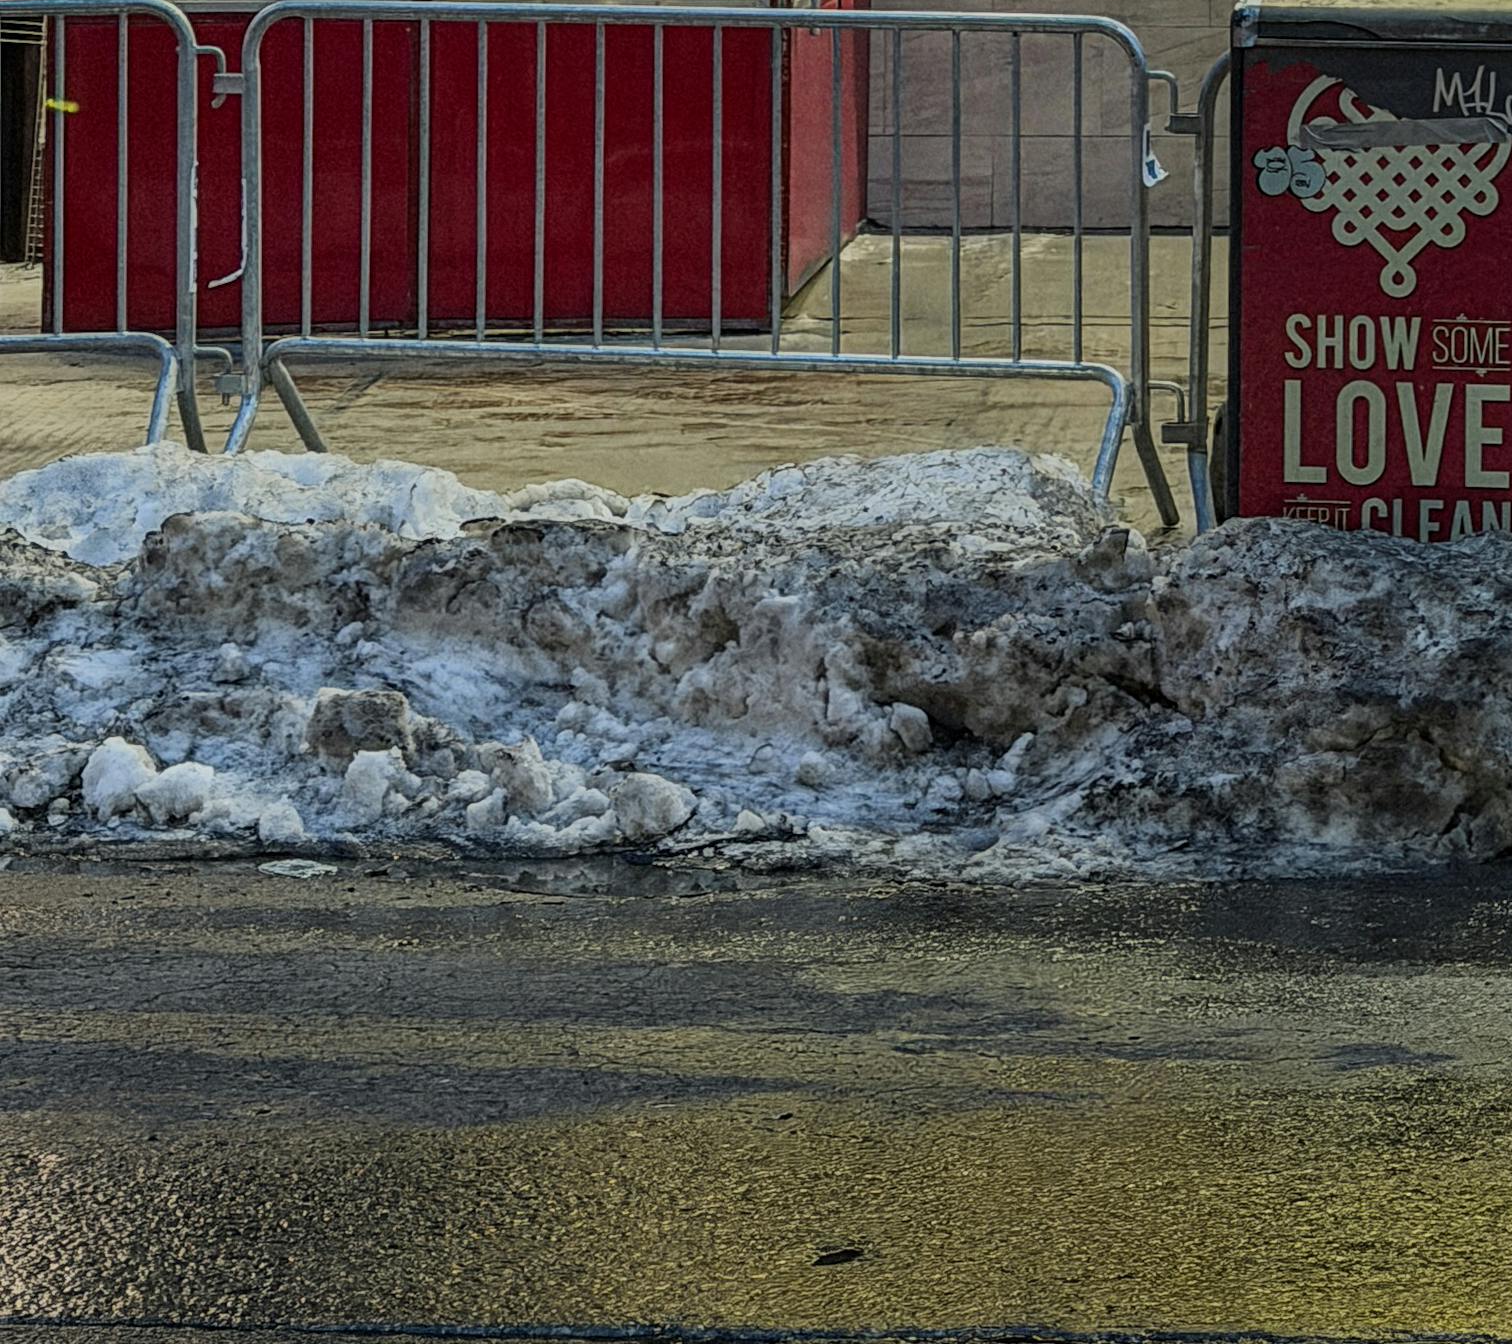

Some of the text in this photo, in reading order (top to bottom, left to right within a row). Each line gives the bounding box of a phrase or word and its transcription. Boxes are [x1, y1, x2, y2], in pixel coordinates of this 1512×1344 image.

[1283, 313, 1512, 372] SHOW SOME
[1283, 378, 1512, 490] LOVE
